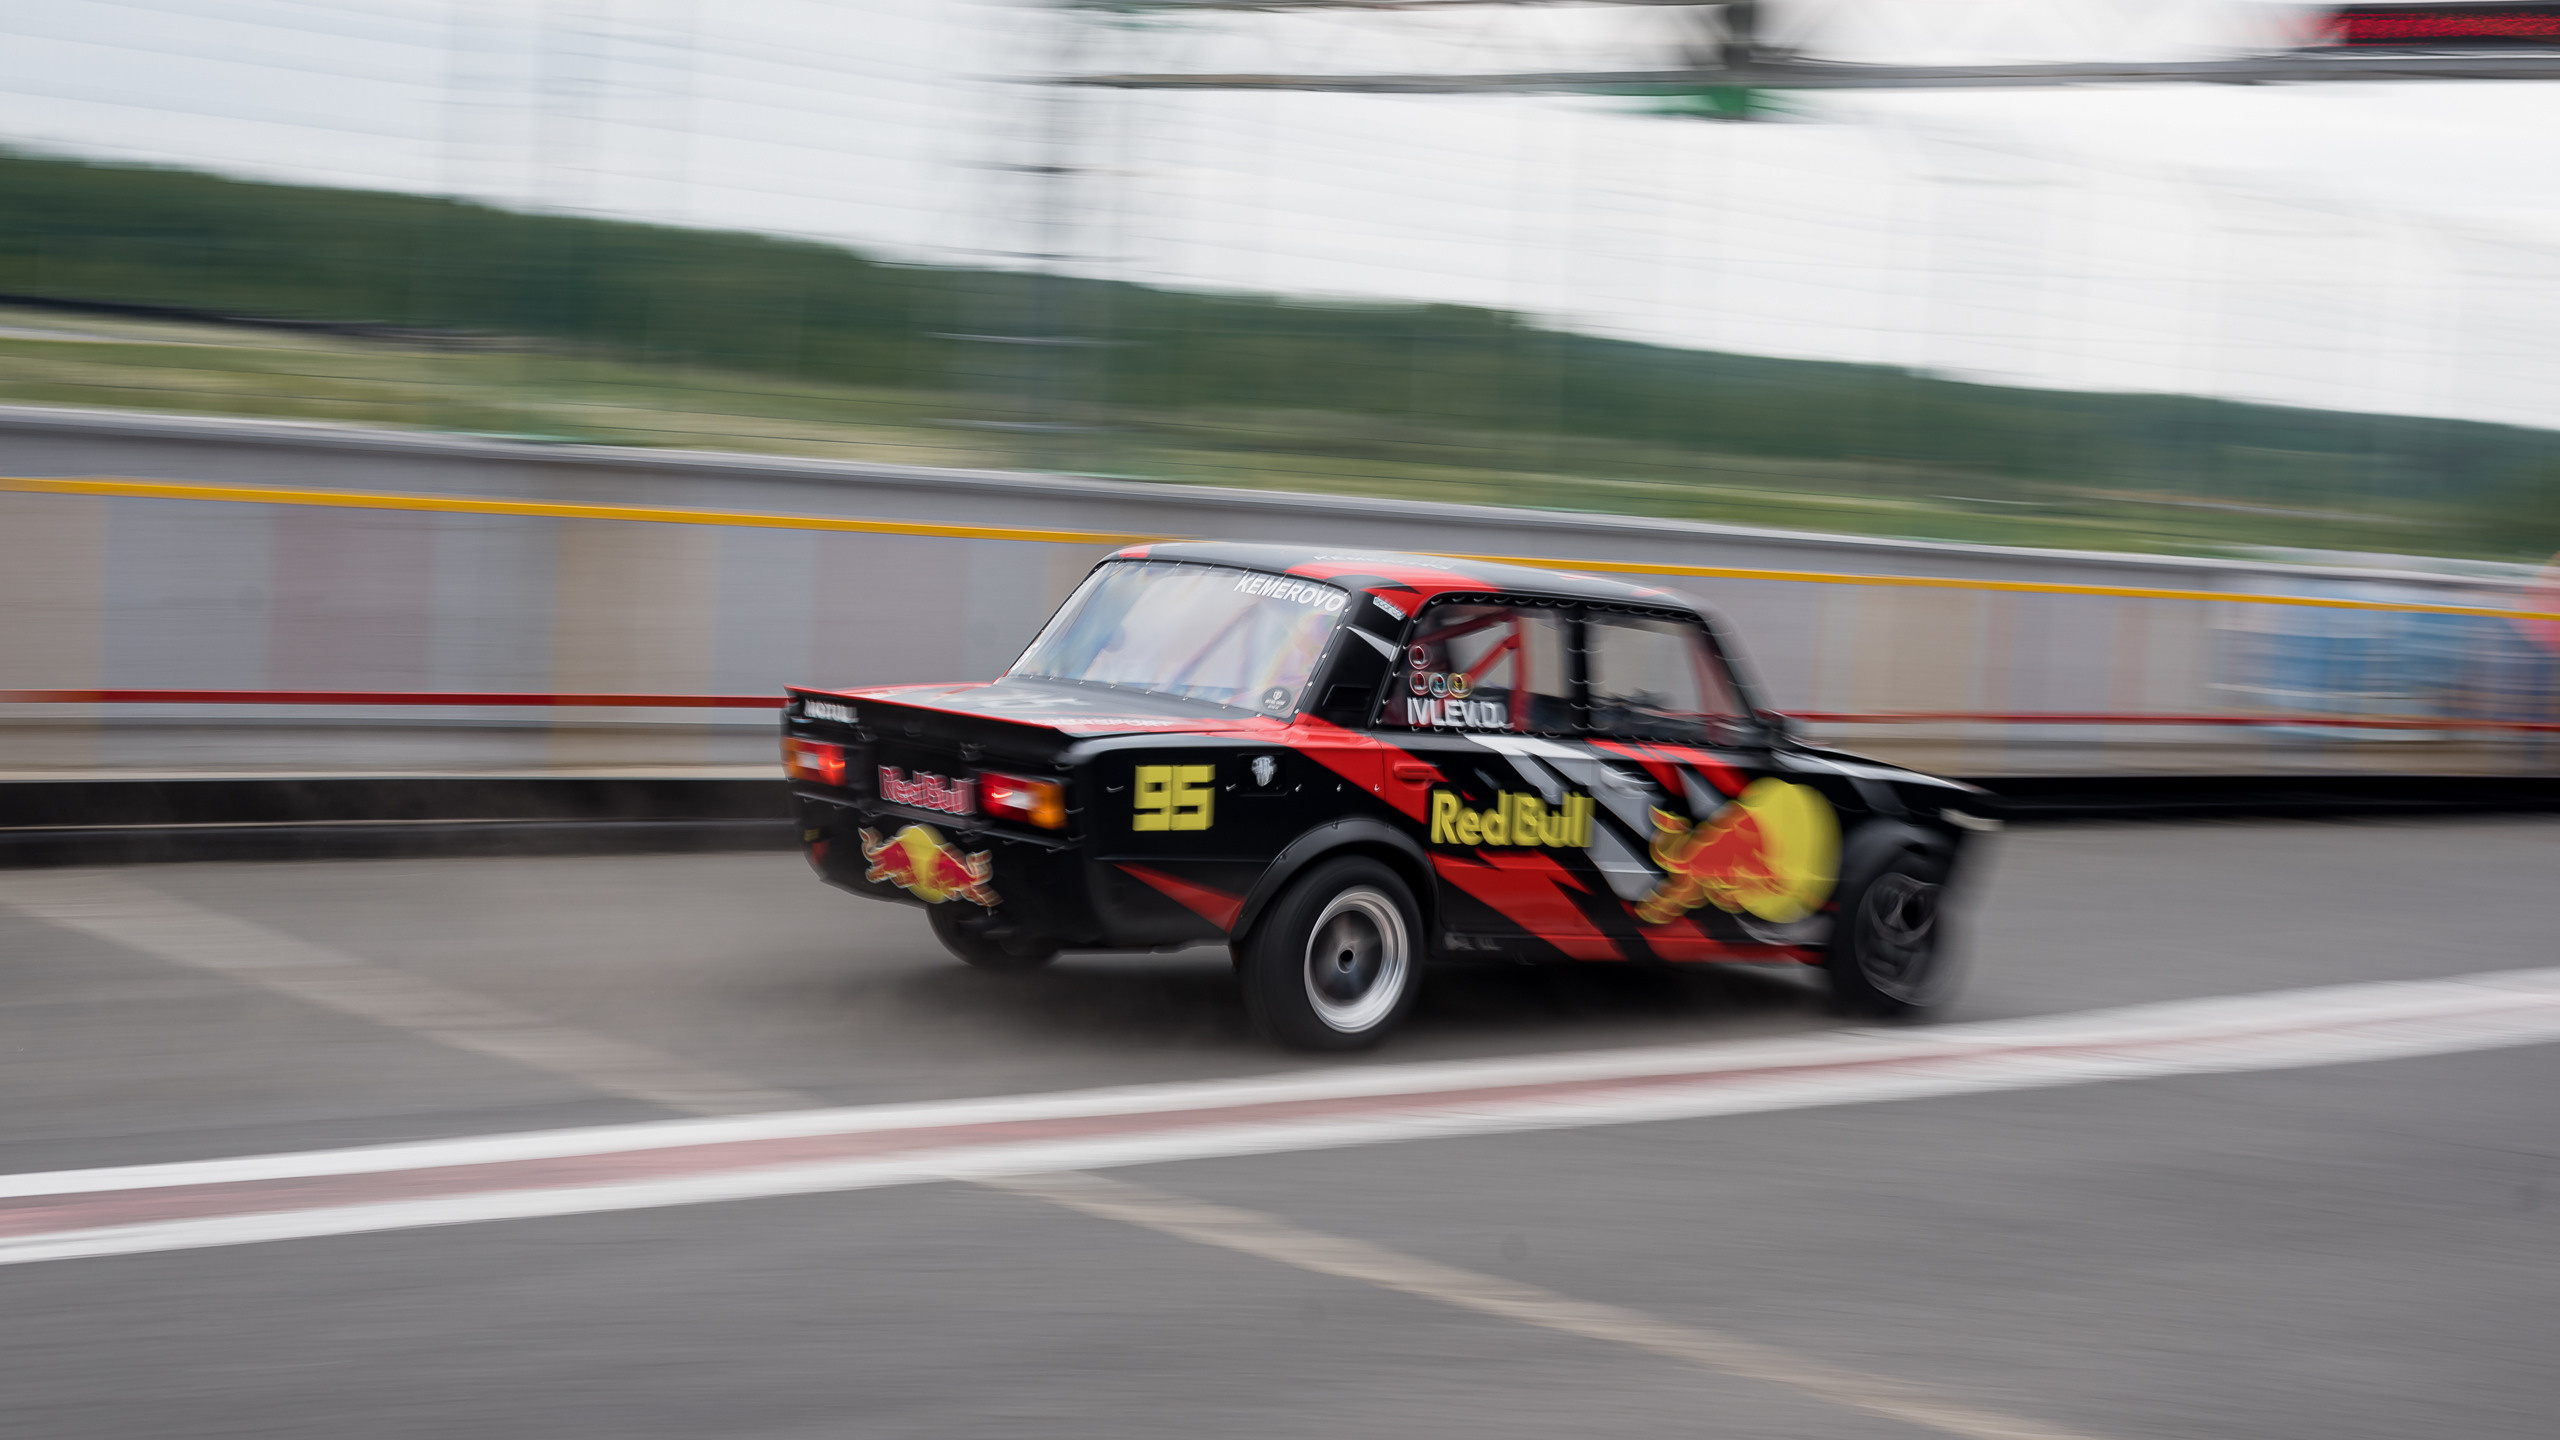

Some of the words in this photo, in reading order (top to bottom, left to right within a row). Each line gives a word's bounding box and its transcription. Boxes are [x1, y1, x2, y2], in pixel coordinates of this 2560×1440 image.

[1233, 572, 1347, 611] KEMEROVO
[878, 764, 928, 808] Red
[922, 773, 977, 816] Bull
[1132, 764, 1216, 831] 95
[1430, 789, 1514, 846] Red
[1511, 791, 1596, 848] Bull
